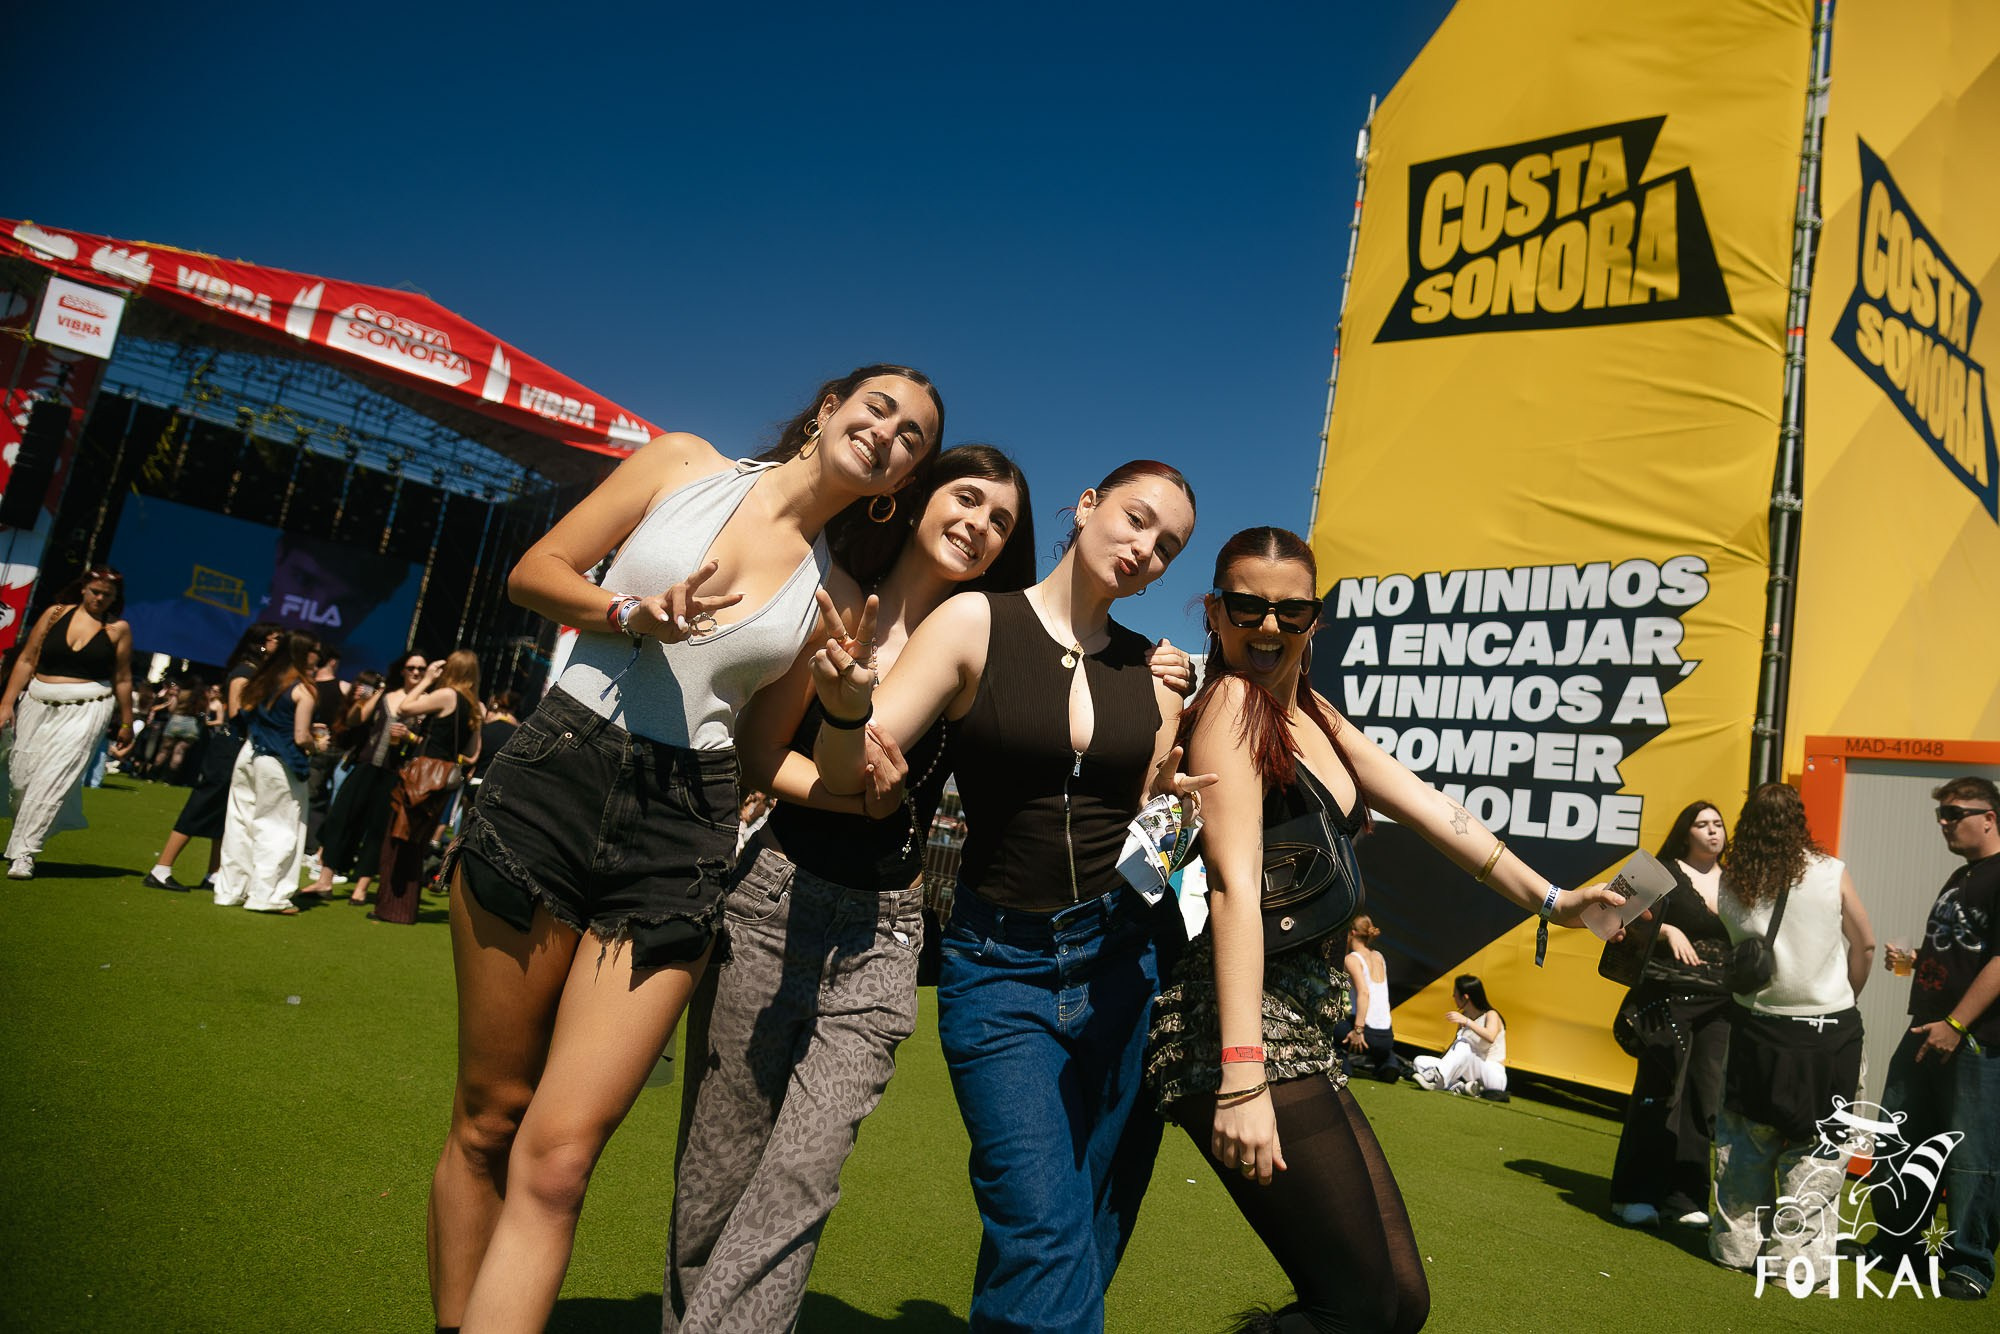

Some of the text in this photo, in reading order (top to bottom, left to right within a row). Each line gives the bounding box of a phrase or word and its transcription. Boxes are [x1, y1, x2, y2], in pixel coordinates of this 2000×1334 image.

[1419, 136, 1629, 270] COSTA
[1411, 180, 1680, 324] SONORA
[1862, 179, 1970, 354] COSTA
[58, 314, 101, 337] VIBRA
[347, 322, 468, 375] SONORA
[354, 307, 448, 350] COSTA
[1855, 302, 1989, 488] SONORA
[281, 594, 342, 627] FILA
[1336, 556, 1709, 618] NO VINIMOS
[1341, 617, 1701, 676] A ENCAJAR,
[1343, 675, 1669, 725] VINIMOS A
[1845, 738, 1945, 757] MAD-41048
